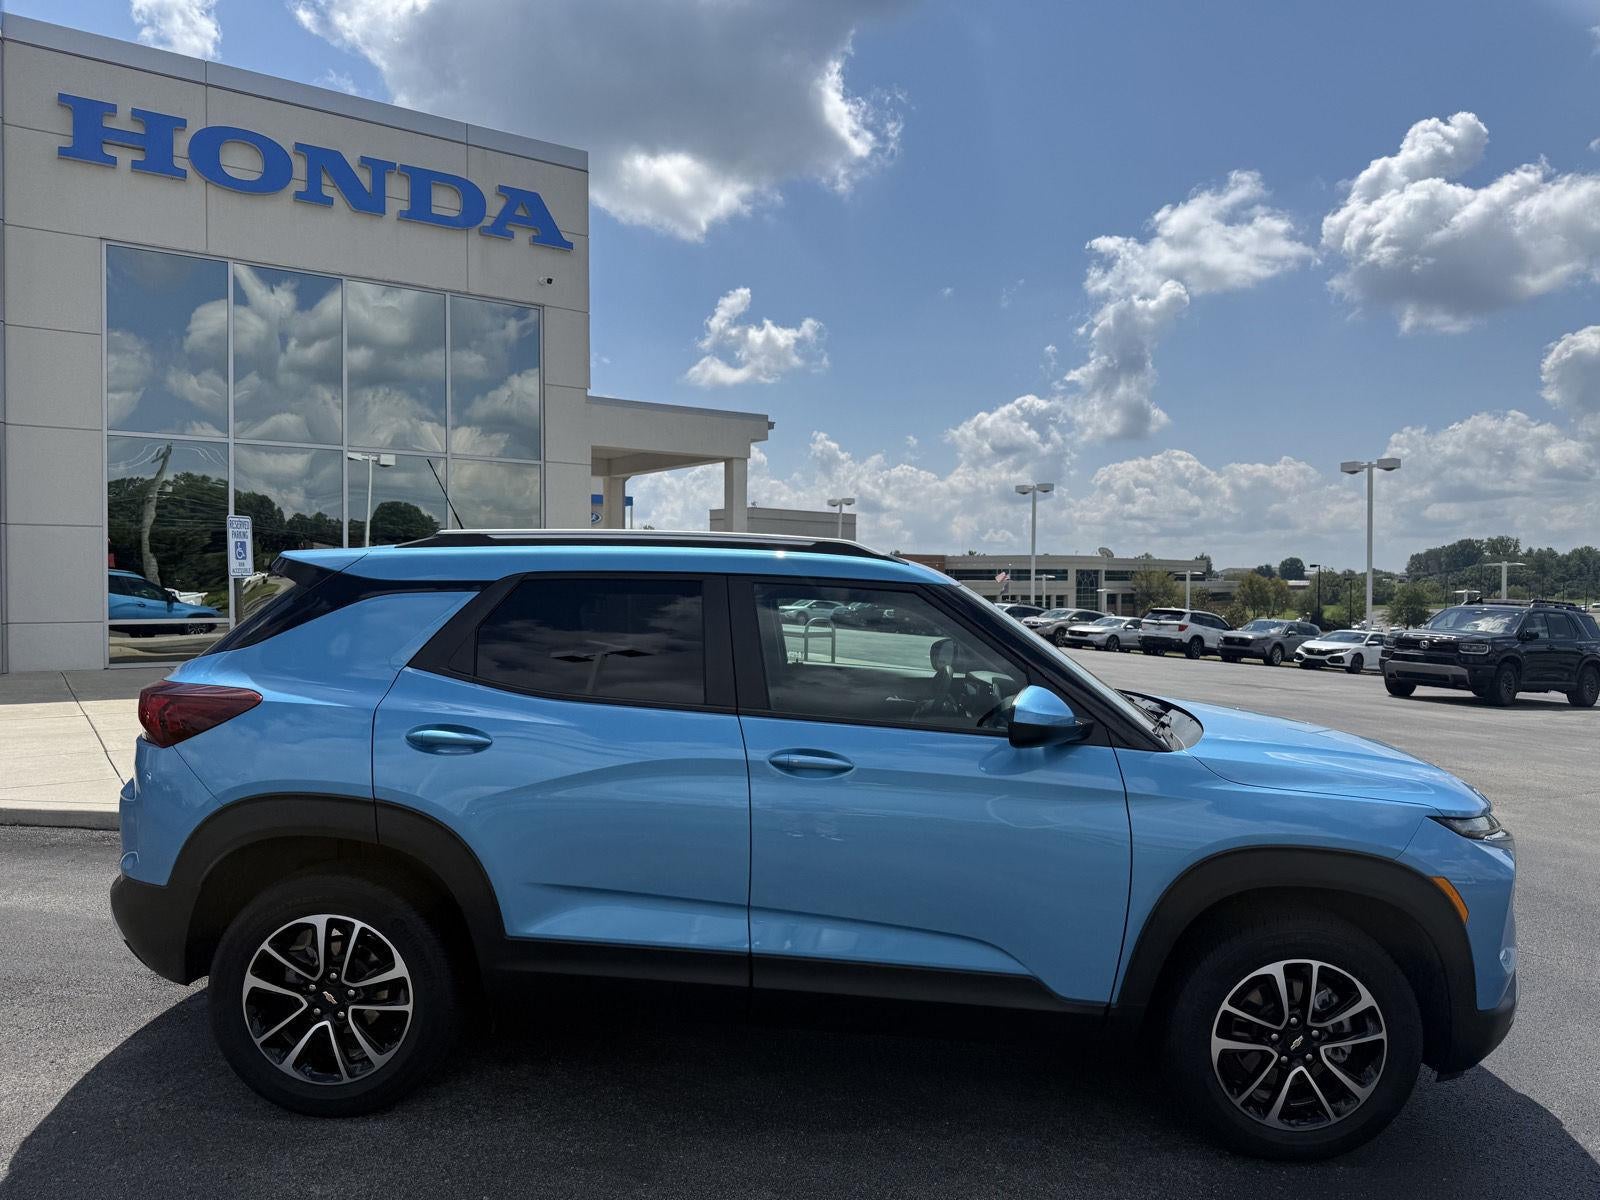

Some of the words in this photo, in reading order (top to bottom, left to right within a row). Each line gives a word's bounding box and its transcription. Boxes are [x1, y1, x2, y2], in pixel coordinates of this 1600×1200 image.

[57, 92, 574, 250] HONDA
[228, 519, 249, 530] RESERVED
[231, 530, 249, 539] PARKING
